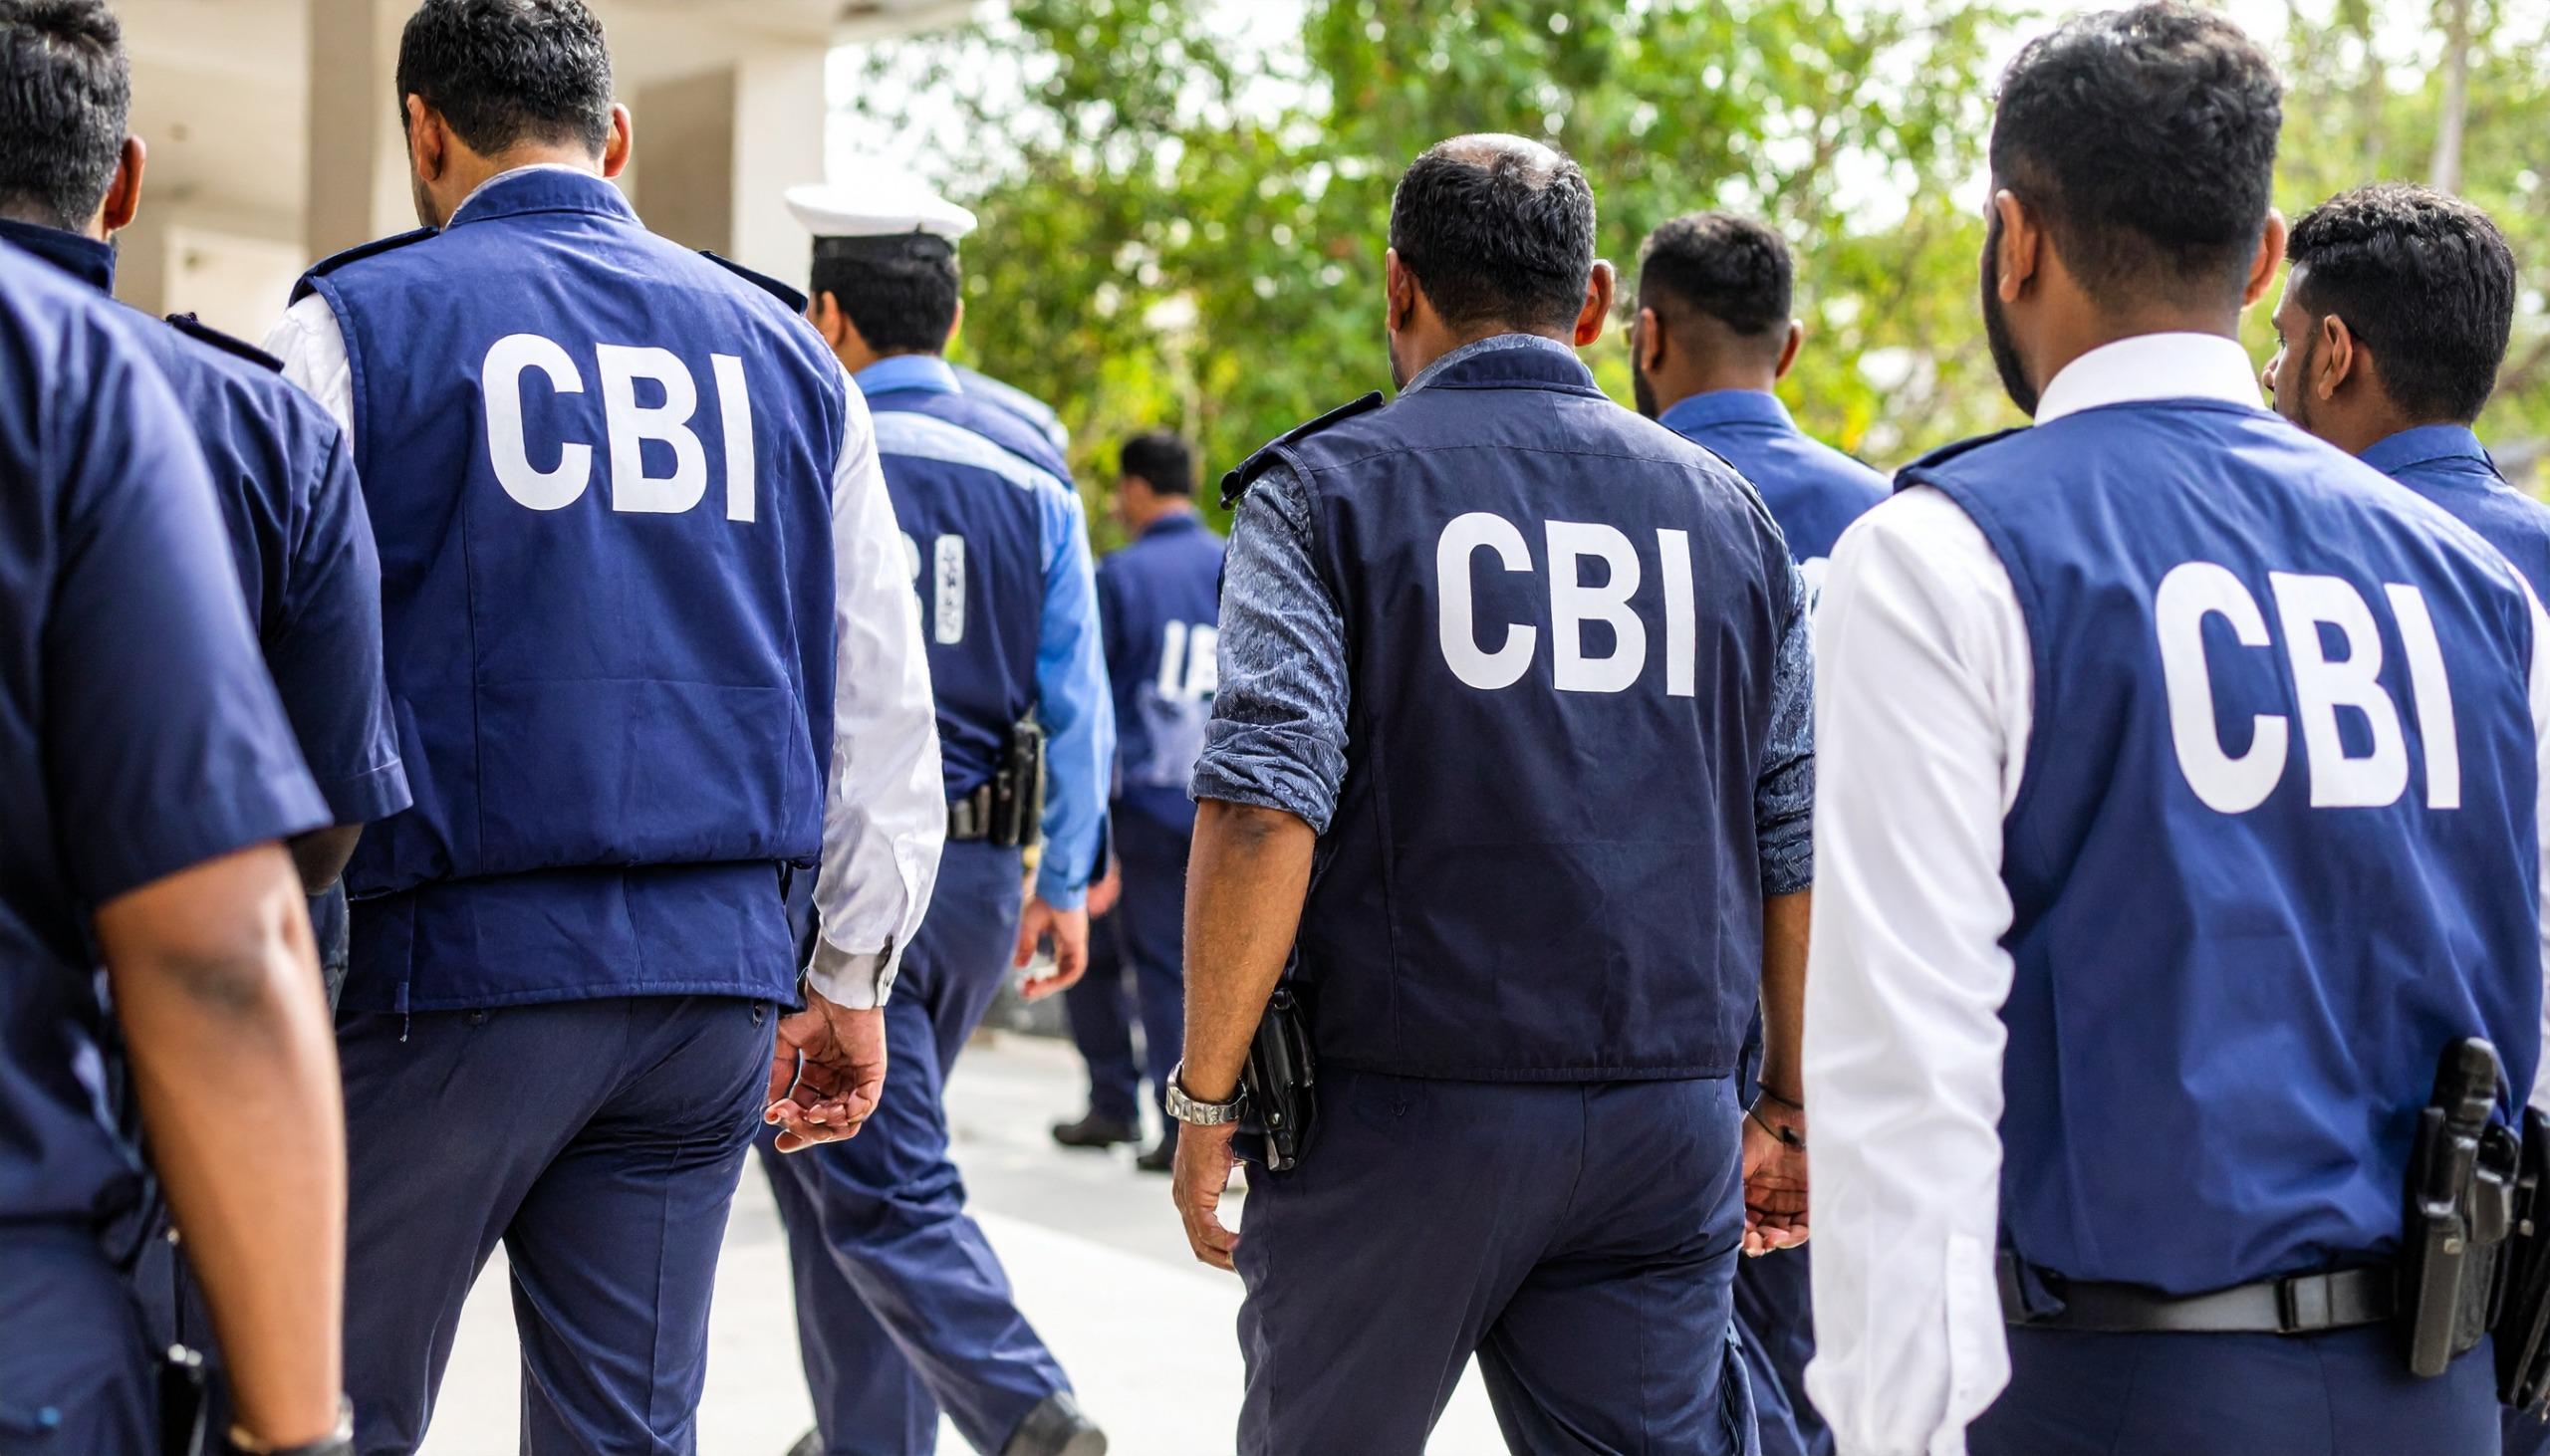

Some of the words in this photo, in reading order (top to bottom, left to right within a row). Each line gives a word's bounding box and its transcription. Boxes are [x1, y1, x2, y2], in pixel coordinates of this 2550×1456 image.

[482, 334, 755, 523] CBI
[1436, 512, 1696, 697] CBI
[2155, 562, 2460, 813] CBI
